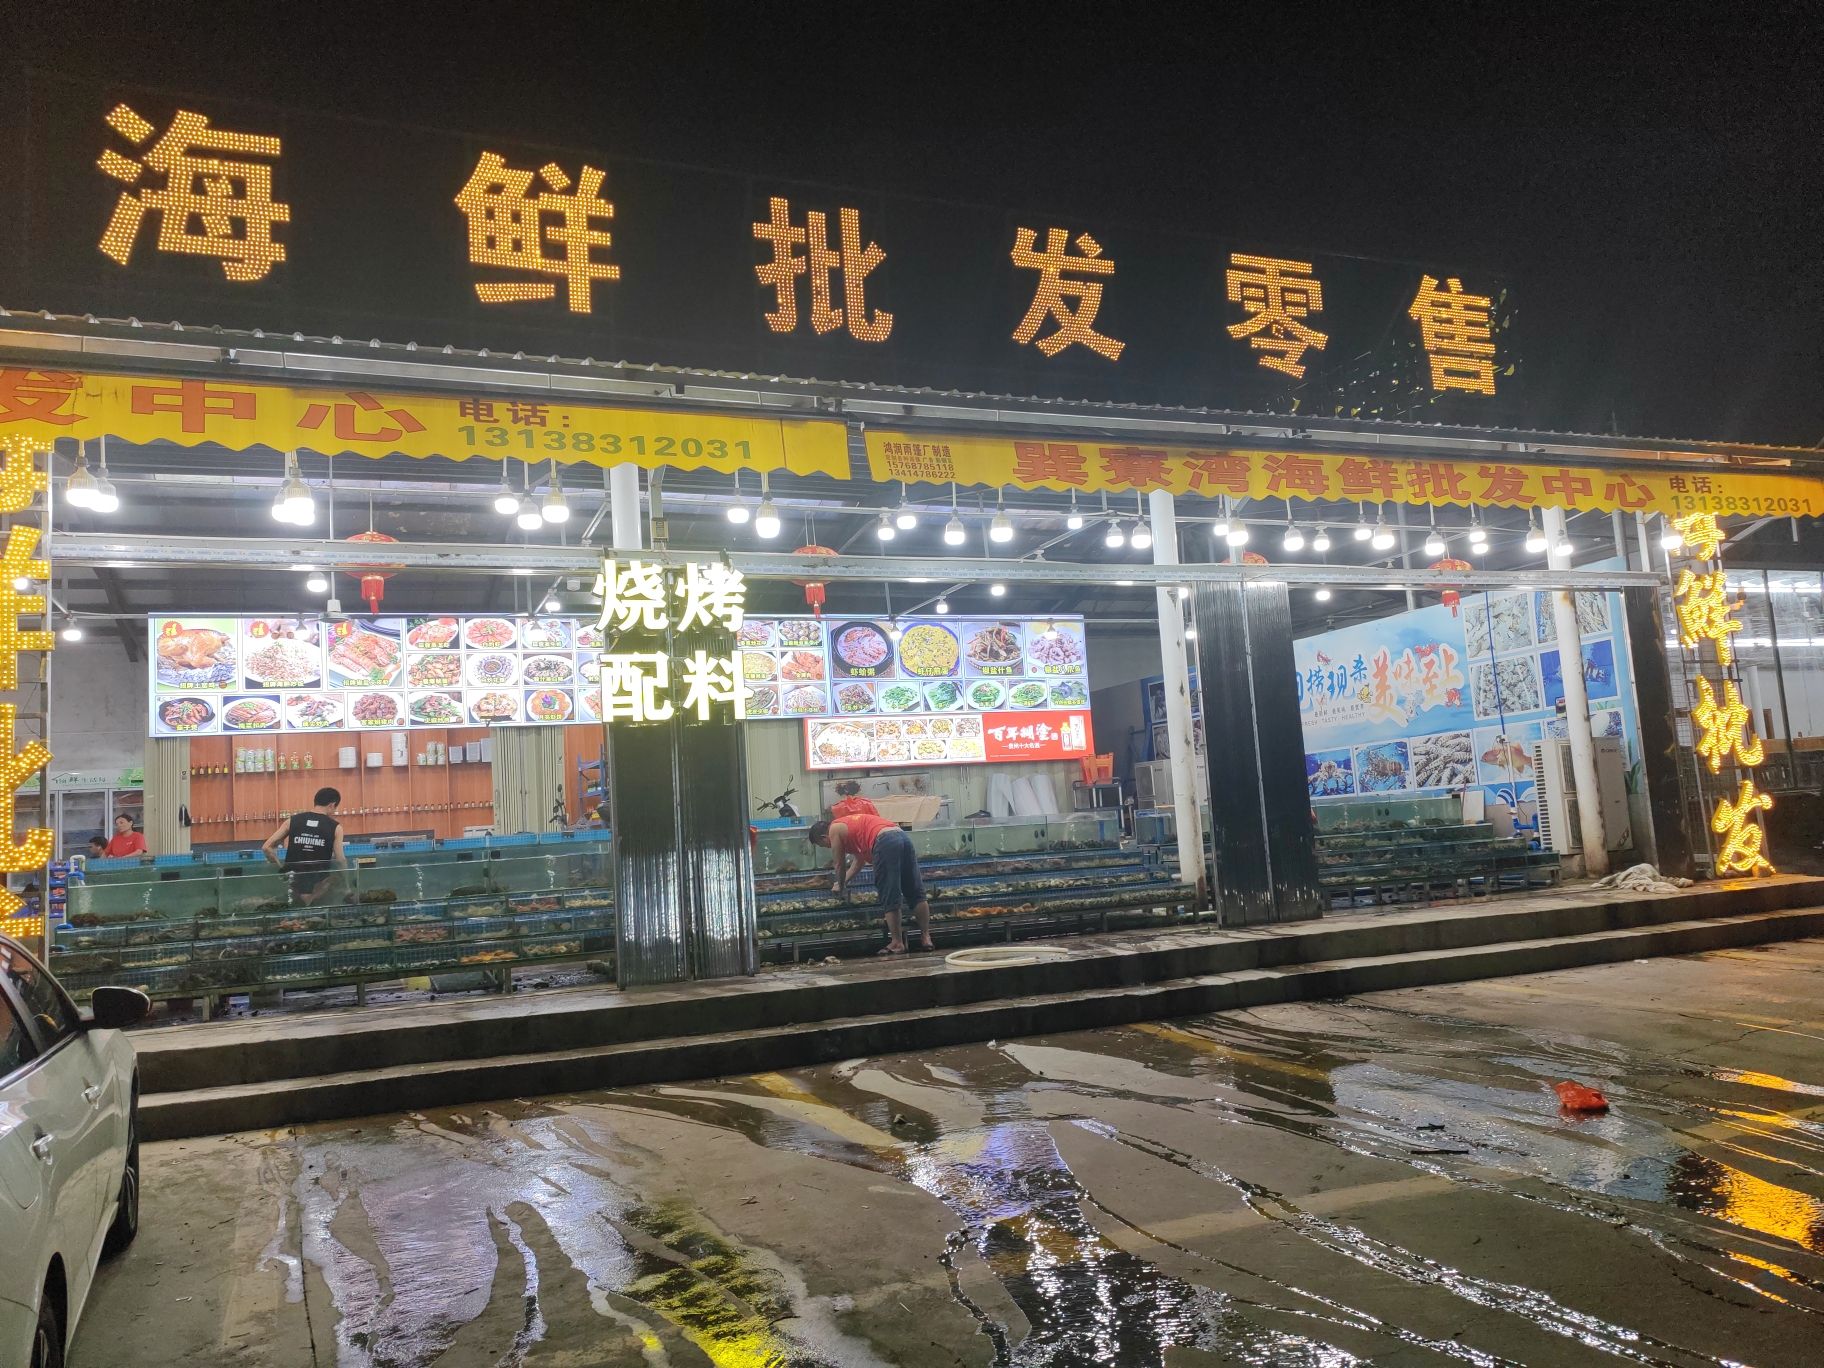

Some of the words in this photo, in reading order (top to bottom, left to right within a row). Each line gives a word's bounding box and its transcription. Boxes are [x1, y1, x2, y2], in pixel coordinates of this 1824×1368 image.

[97, 103, 1496, 395] 海鲜批发零售
[457, 425, 752, 460] 13138312031
[1670, 495, 1812, 513] 13138312031
[592, 559, 748, 632] 烧烤
[600, 650, 754, 723] 配料
